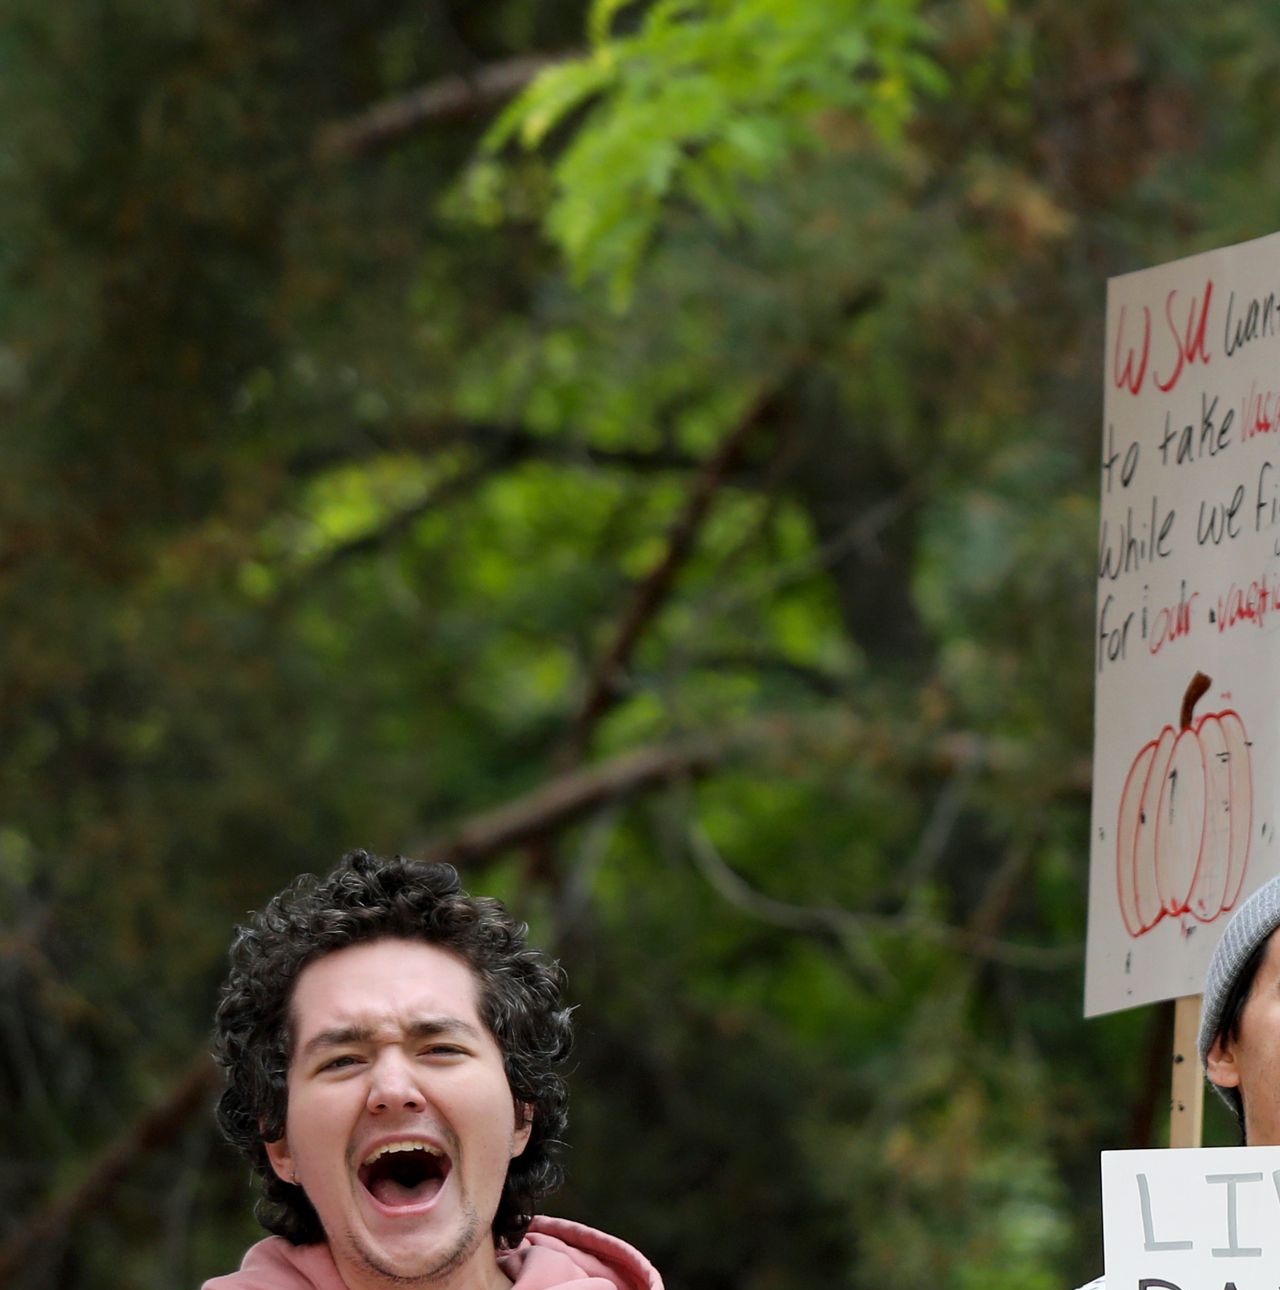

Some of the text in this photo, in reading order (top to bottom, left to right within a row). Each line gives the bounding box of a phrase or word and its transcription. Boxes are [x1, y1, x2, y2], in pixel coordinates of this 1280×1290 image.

[1113, 278, 1212, 396] WSU
[1102, 421, 1141, 494] to
[1158, 391, 1235, 466] take
[1197, 484, 1245, 546] we
[1099, 593, 1135, 674] for
